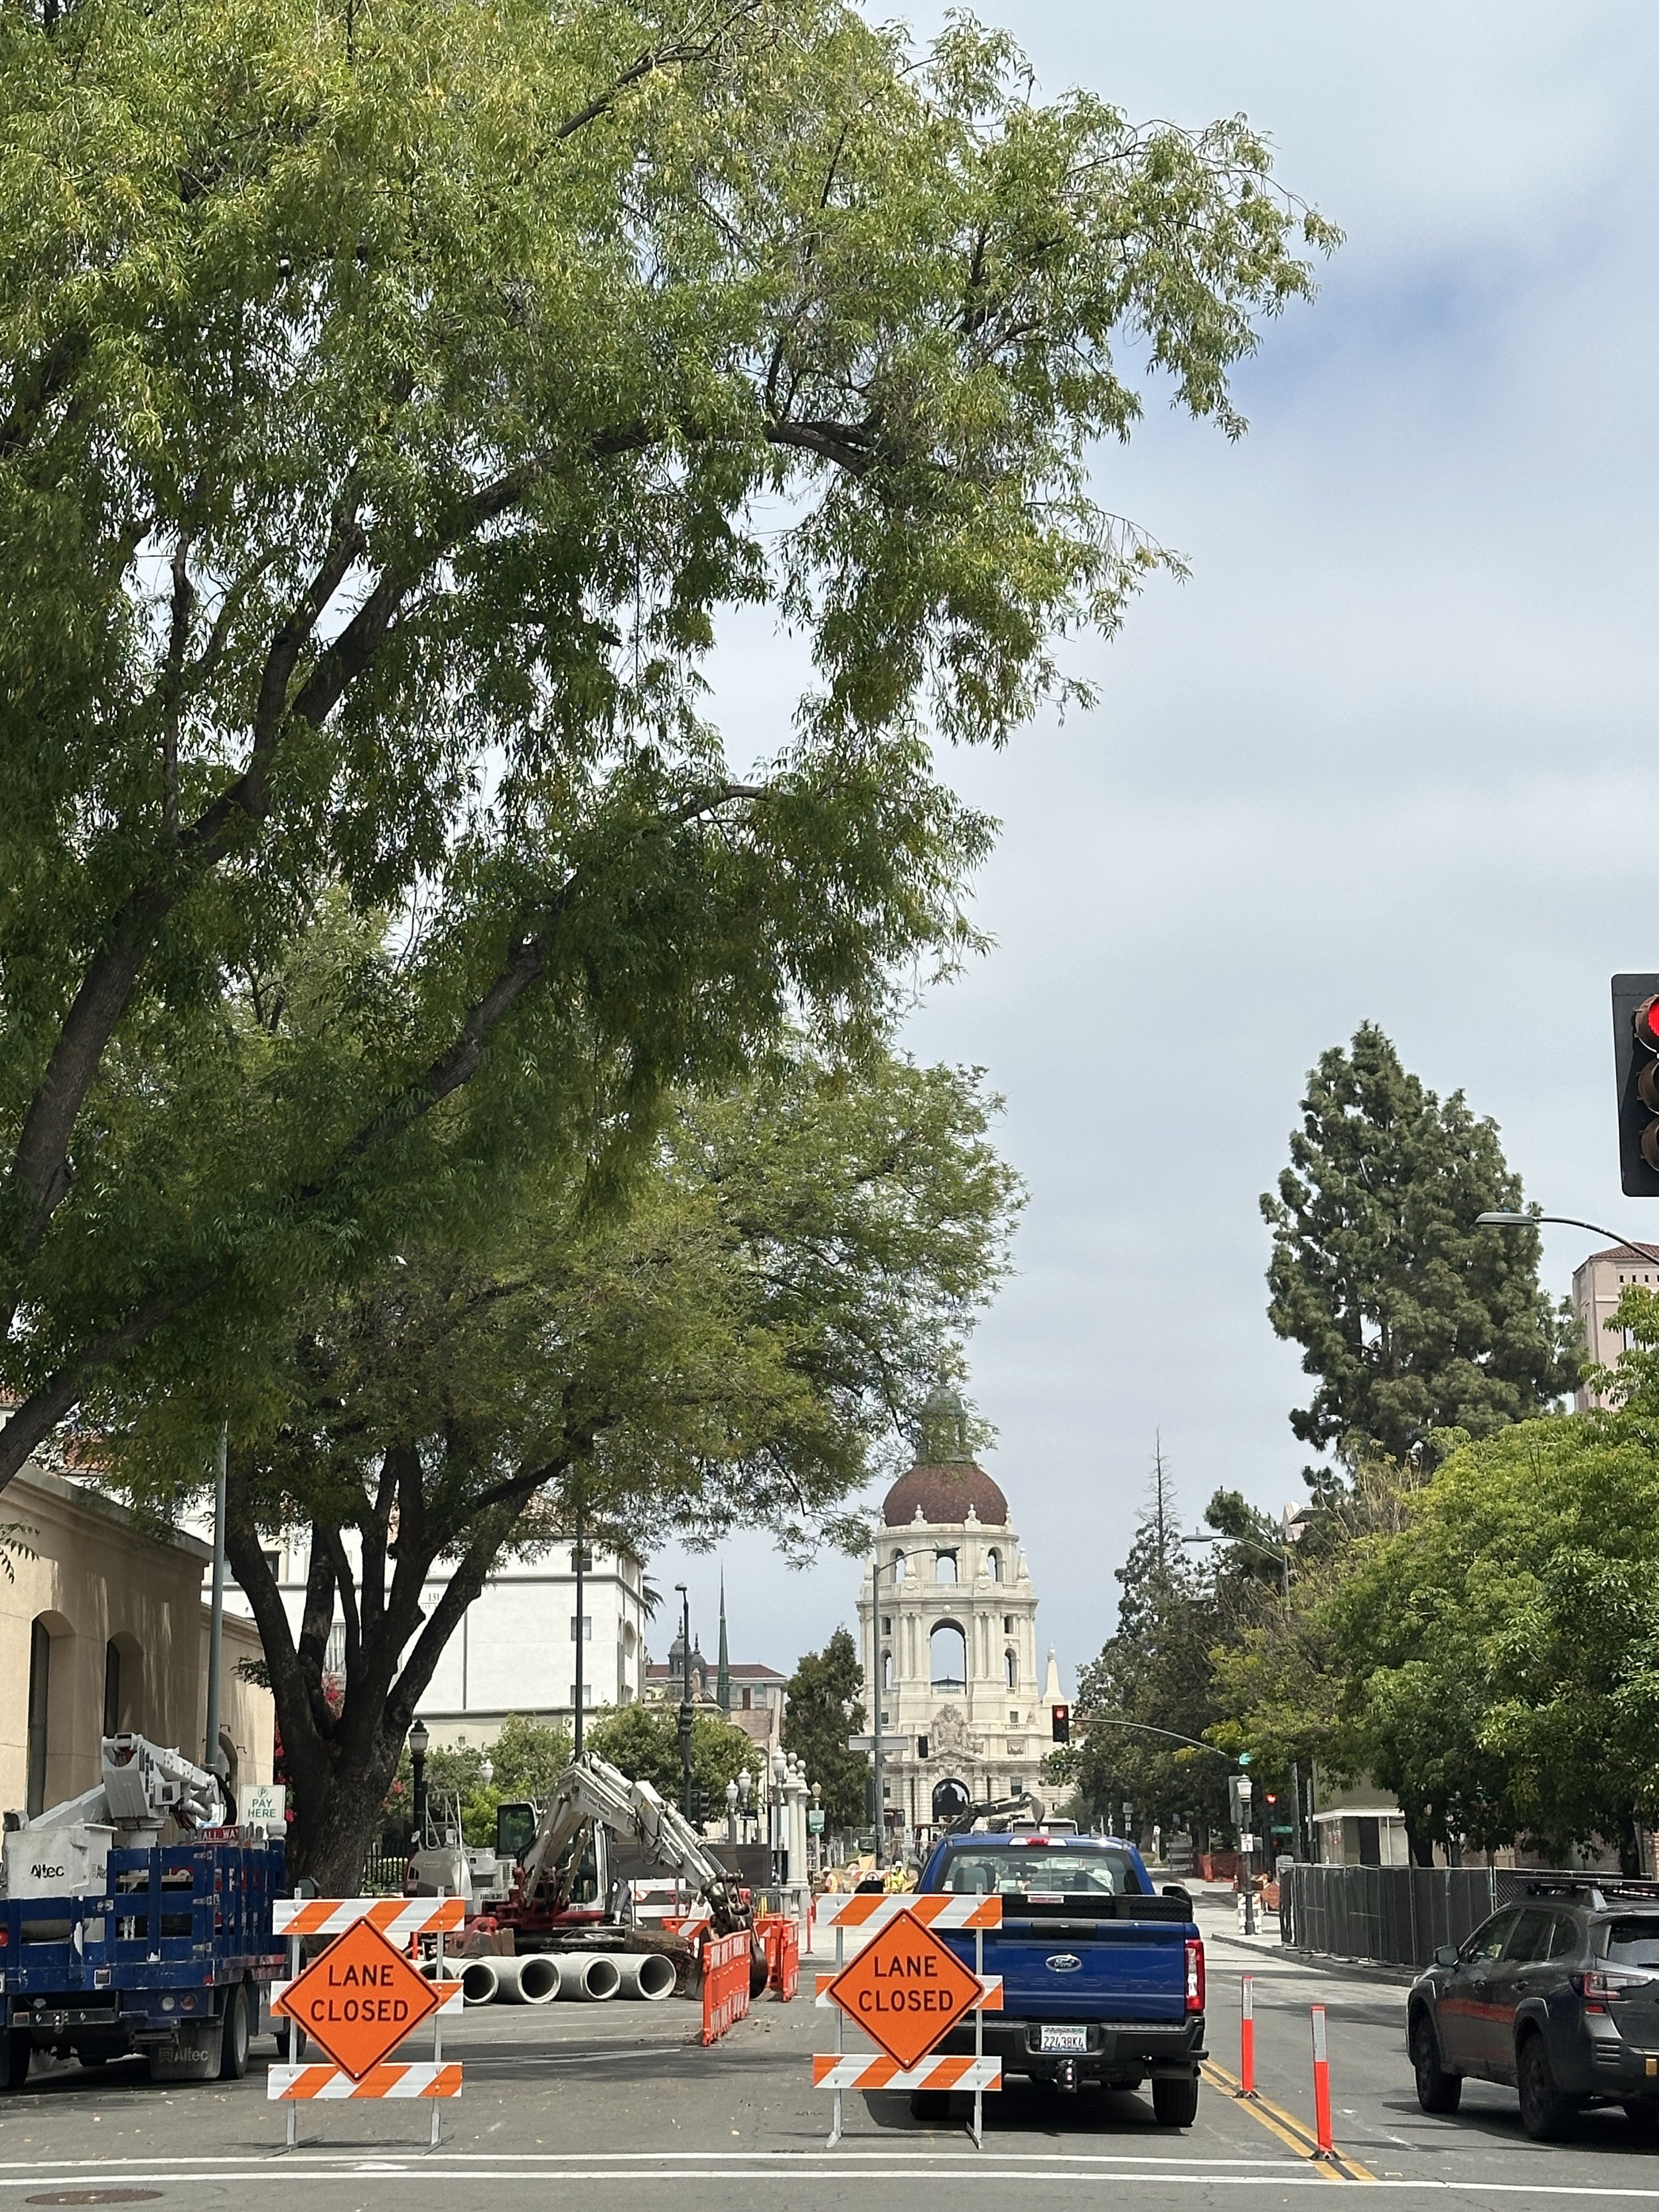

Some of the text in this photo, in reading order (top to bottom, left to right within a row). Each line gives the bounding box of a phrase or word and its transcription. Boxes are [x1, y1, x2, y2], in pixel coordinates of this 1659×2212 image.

[428, 1593, 439, 1601] 131
[252, 1799, 272, 1808] PAY
[248, 1808, 276, 1818] HERE
[202, 1830, 220, 1841] ALL
[31, 1864, 65, 1880] Altec
[873, 1955, 938, 1978] LANE
[1054, 1958, 1075, 1967] Ford
[328, 1964, 394, 1987] LANE
[857, 1989, 954, 2012] CLOSED
[310, 1999, 409, 2022] CLOSED
[174, 2046, 209, 2062] Altec
